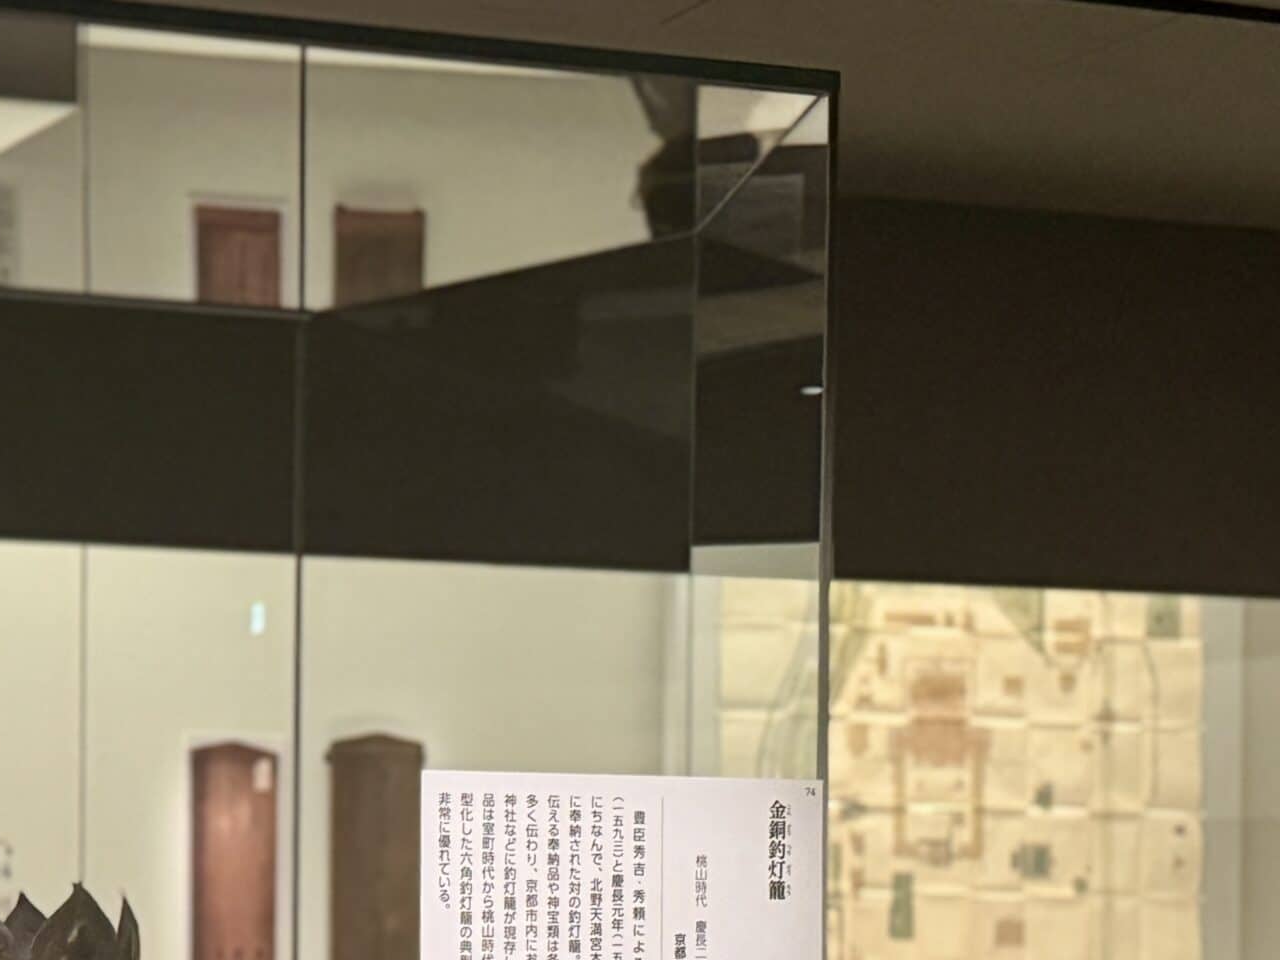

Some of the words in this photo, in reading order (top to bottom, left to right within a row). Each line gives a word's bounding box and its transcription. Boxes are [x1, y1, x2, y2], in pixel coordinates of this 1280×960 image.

[805, 787, 816, 797] 74
[438, 792, 451, 909] 非常に優れている。
[768, 800, 786, 900] 金銅釣灯籠
[696, 855, 707, 907] 桃山時代
[674, 933, 686, 960] 京都
